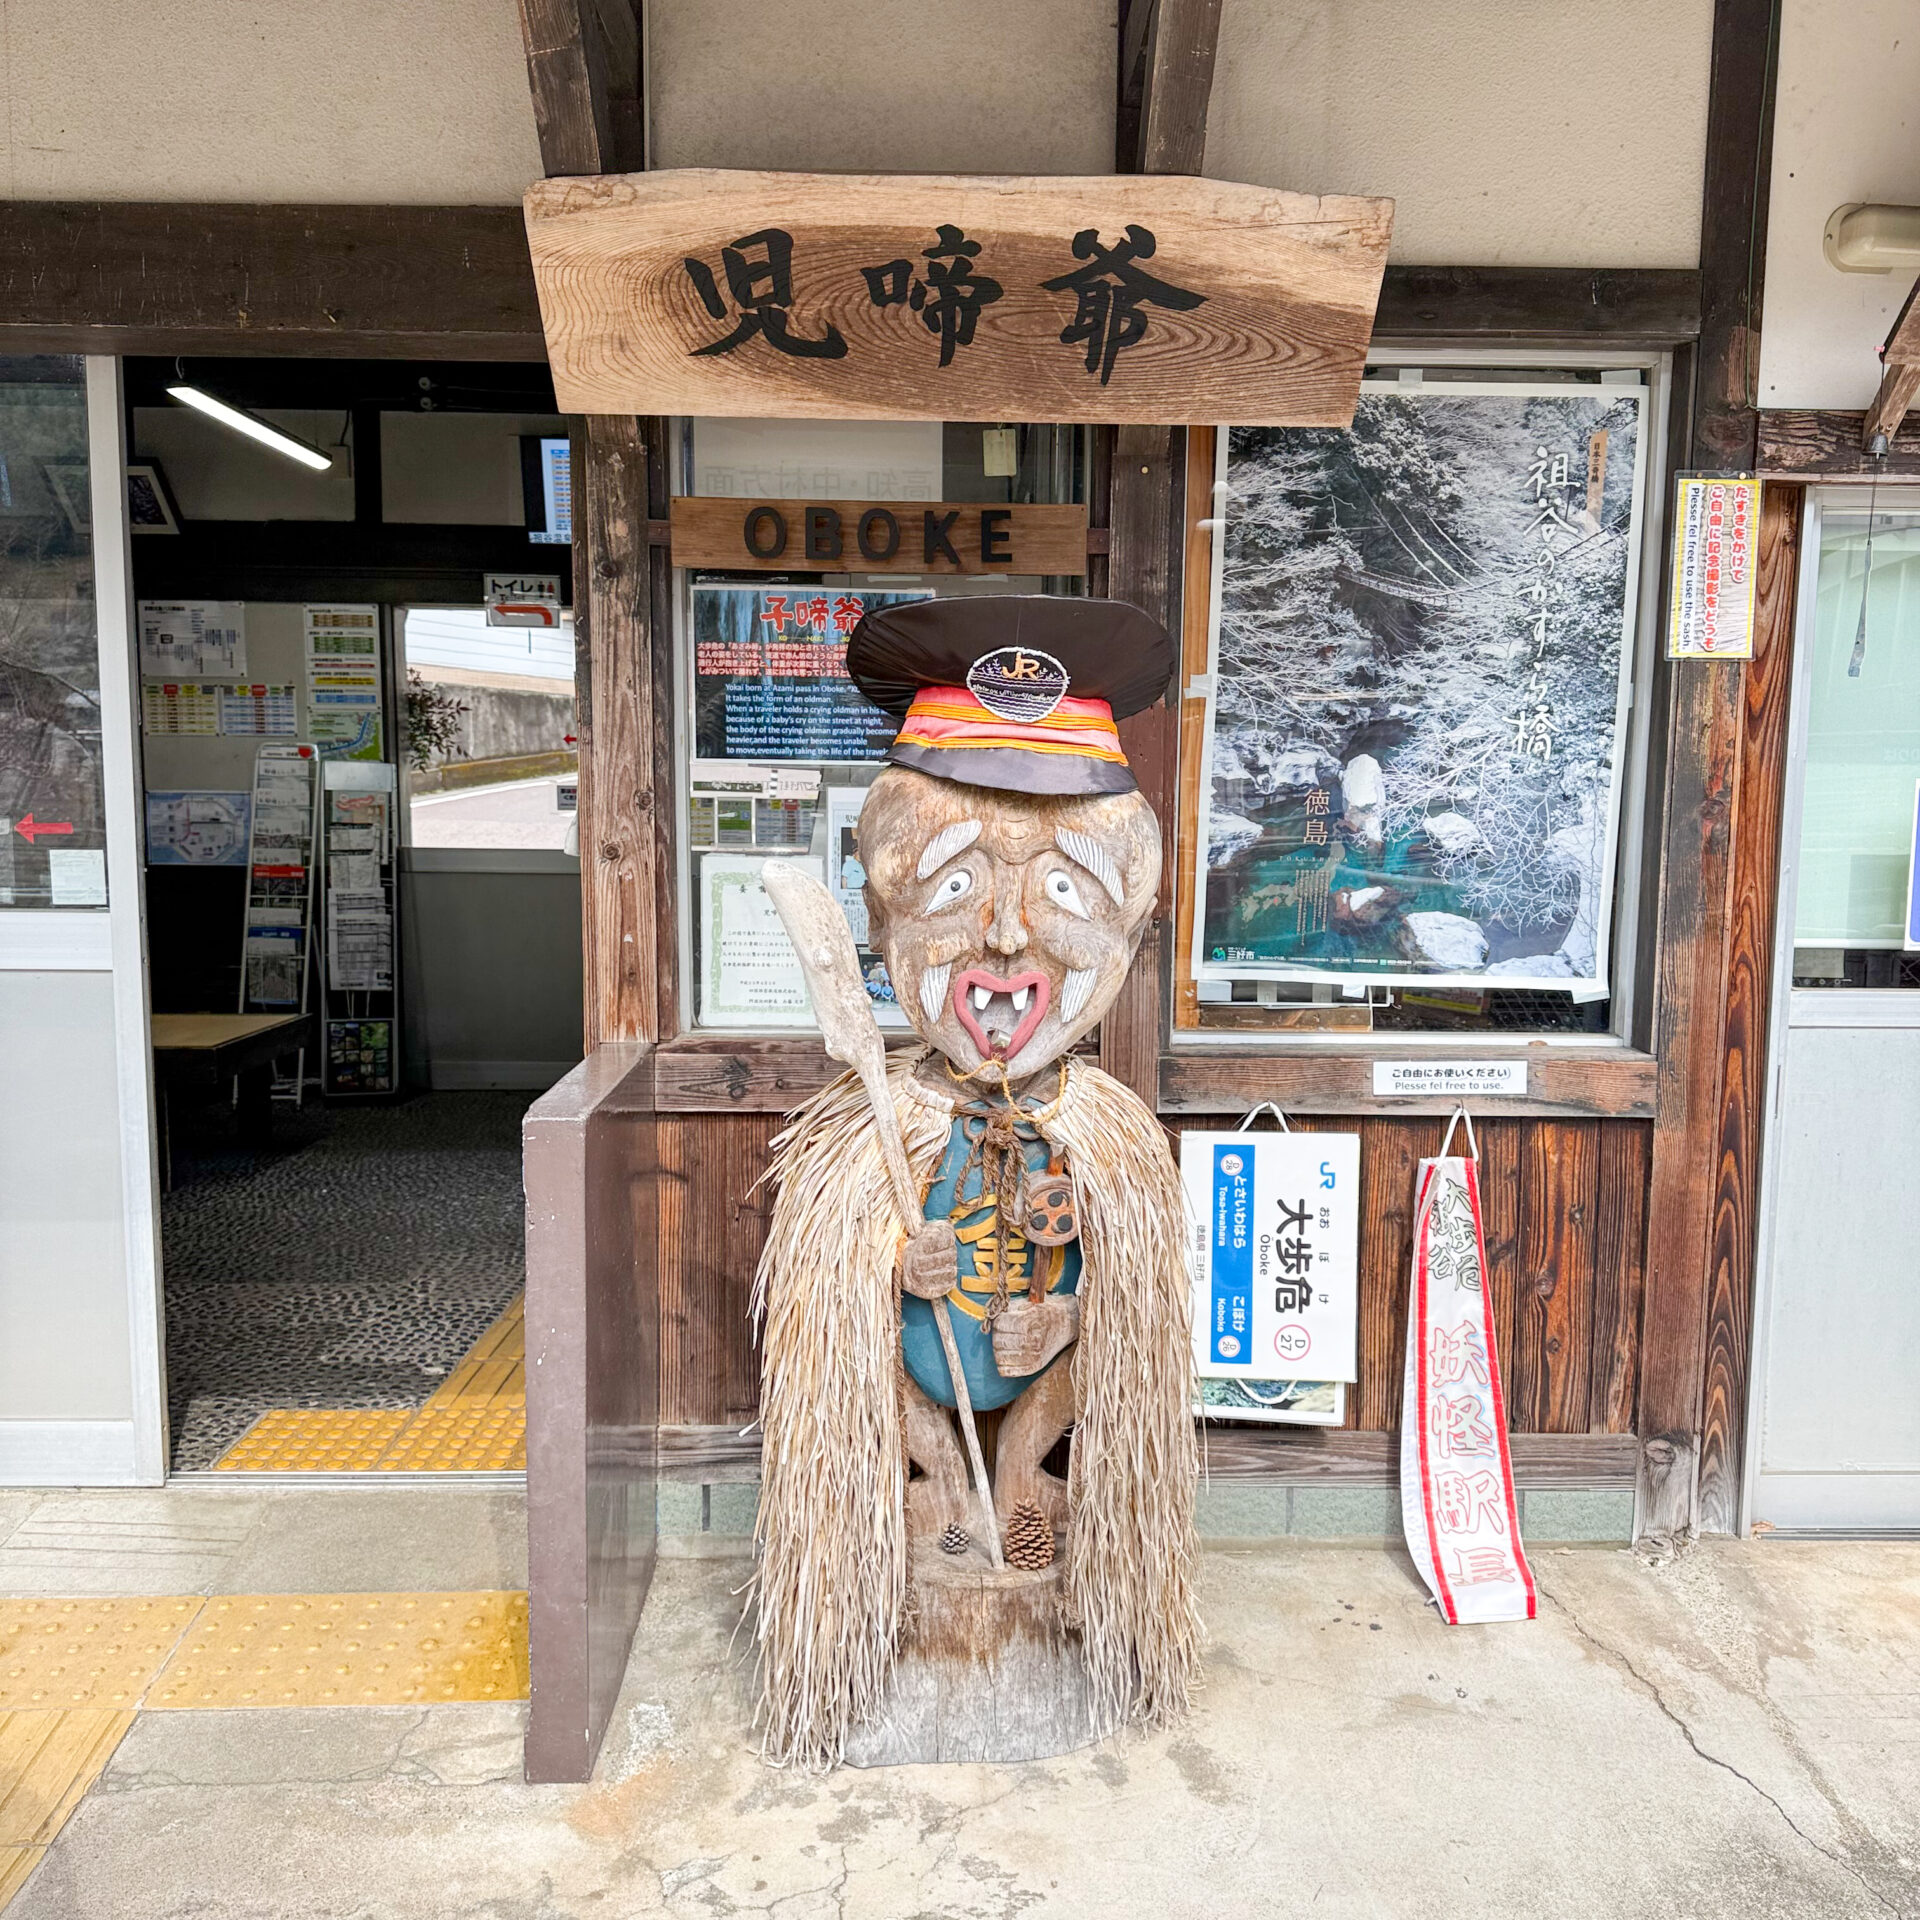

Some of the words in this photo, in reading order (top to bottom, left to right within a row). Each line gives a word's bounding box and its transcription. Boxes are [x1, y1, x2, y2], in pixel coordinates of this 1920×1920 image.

[683, 224, 1209, 386] 児啼爺
[744, 506, 1014, 563] OBOKE
[1731, 486, 1749, 581] たすきをかけて
[1687, 541, 1697, 562] free
[1686, 565, 1694, 577] to
[1703, 485, 1725, 650] ご自由に記念撮影をどうぞ
[491, 579, 534, 595] トイレ
[1685, 579, 1693, 598] use
[760, 596, 865, 633] 子啼爺
[1502, 446, 1581, 765] 祖谷のかずら橋
[1684, 601, 1693, 618] the
[1682, 621, 1691, 650] sash.
[1001, 652, 1041, 681] JR
[763, 684, 771, 692] at
[772, 684, 794, 692] Azami
[795, 686, 812, 694] pass
[813, 684, 820, 692] in
[804, 695, 833, 703] oldman.
[726, 705, 747, 713] When
[810, 706, 831, 715] crying
[739, 726, 758, 735] body
[781, 727, 803, 736] crying
[832, 727, 865, 736] gradually
[866, 727, 897, 735] becomes
[795, 718, 807, 726] cry
[863, 717, 883, 726] night,
[810, 737, 841, 745] becomes
[795, 748, 816, 757] taking
[1303, 788, 1330, 847] 徳島
[1227, 951, 1256, 961] 三好市
[1391, 1068, 1508, 1078] ご自由にお使いください
[1445, 1081, 1466, 1090] free
[1469, 1082, 1480, 1090] to
[1225, 1160, 1233, 1171] 28
[1320, 1161, 1336, 1190] JR
[1233, 1175, 1247, 1249] とさいわはら
[1319, 1207, 1330, 1228] おお
[1196, 1225, 1206, 1251] 徳島県
[1446, 1177, 1482, 1292] 大歩危
[1276, 1198, 1314, 1315] 大歩危
[1195, 1254, 1206, 1282] 三好市
[1318, 1293, 1329, 1305] け
[1216, 1297, 1227, 1333] Koboke
[1232, 1295, 1245, 1333] こぼけ
[1222, 1341, 1230, 1352] 26
[1280, 1334, 1291, 1351] 27
[1295, 1339, 1306, 1348] D
[1433, 1320, 1518, 1588] 妖怪駅長
